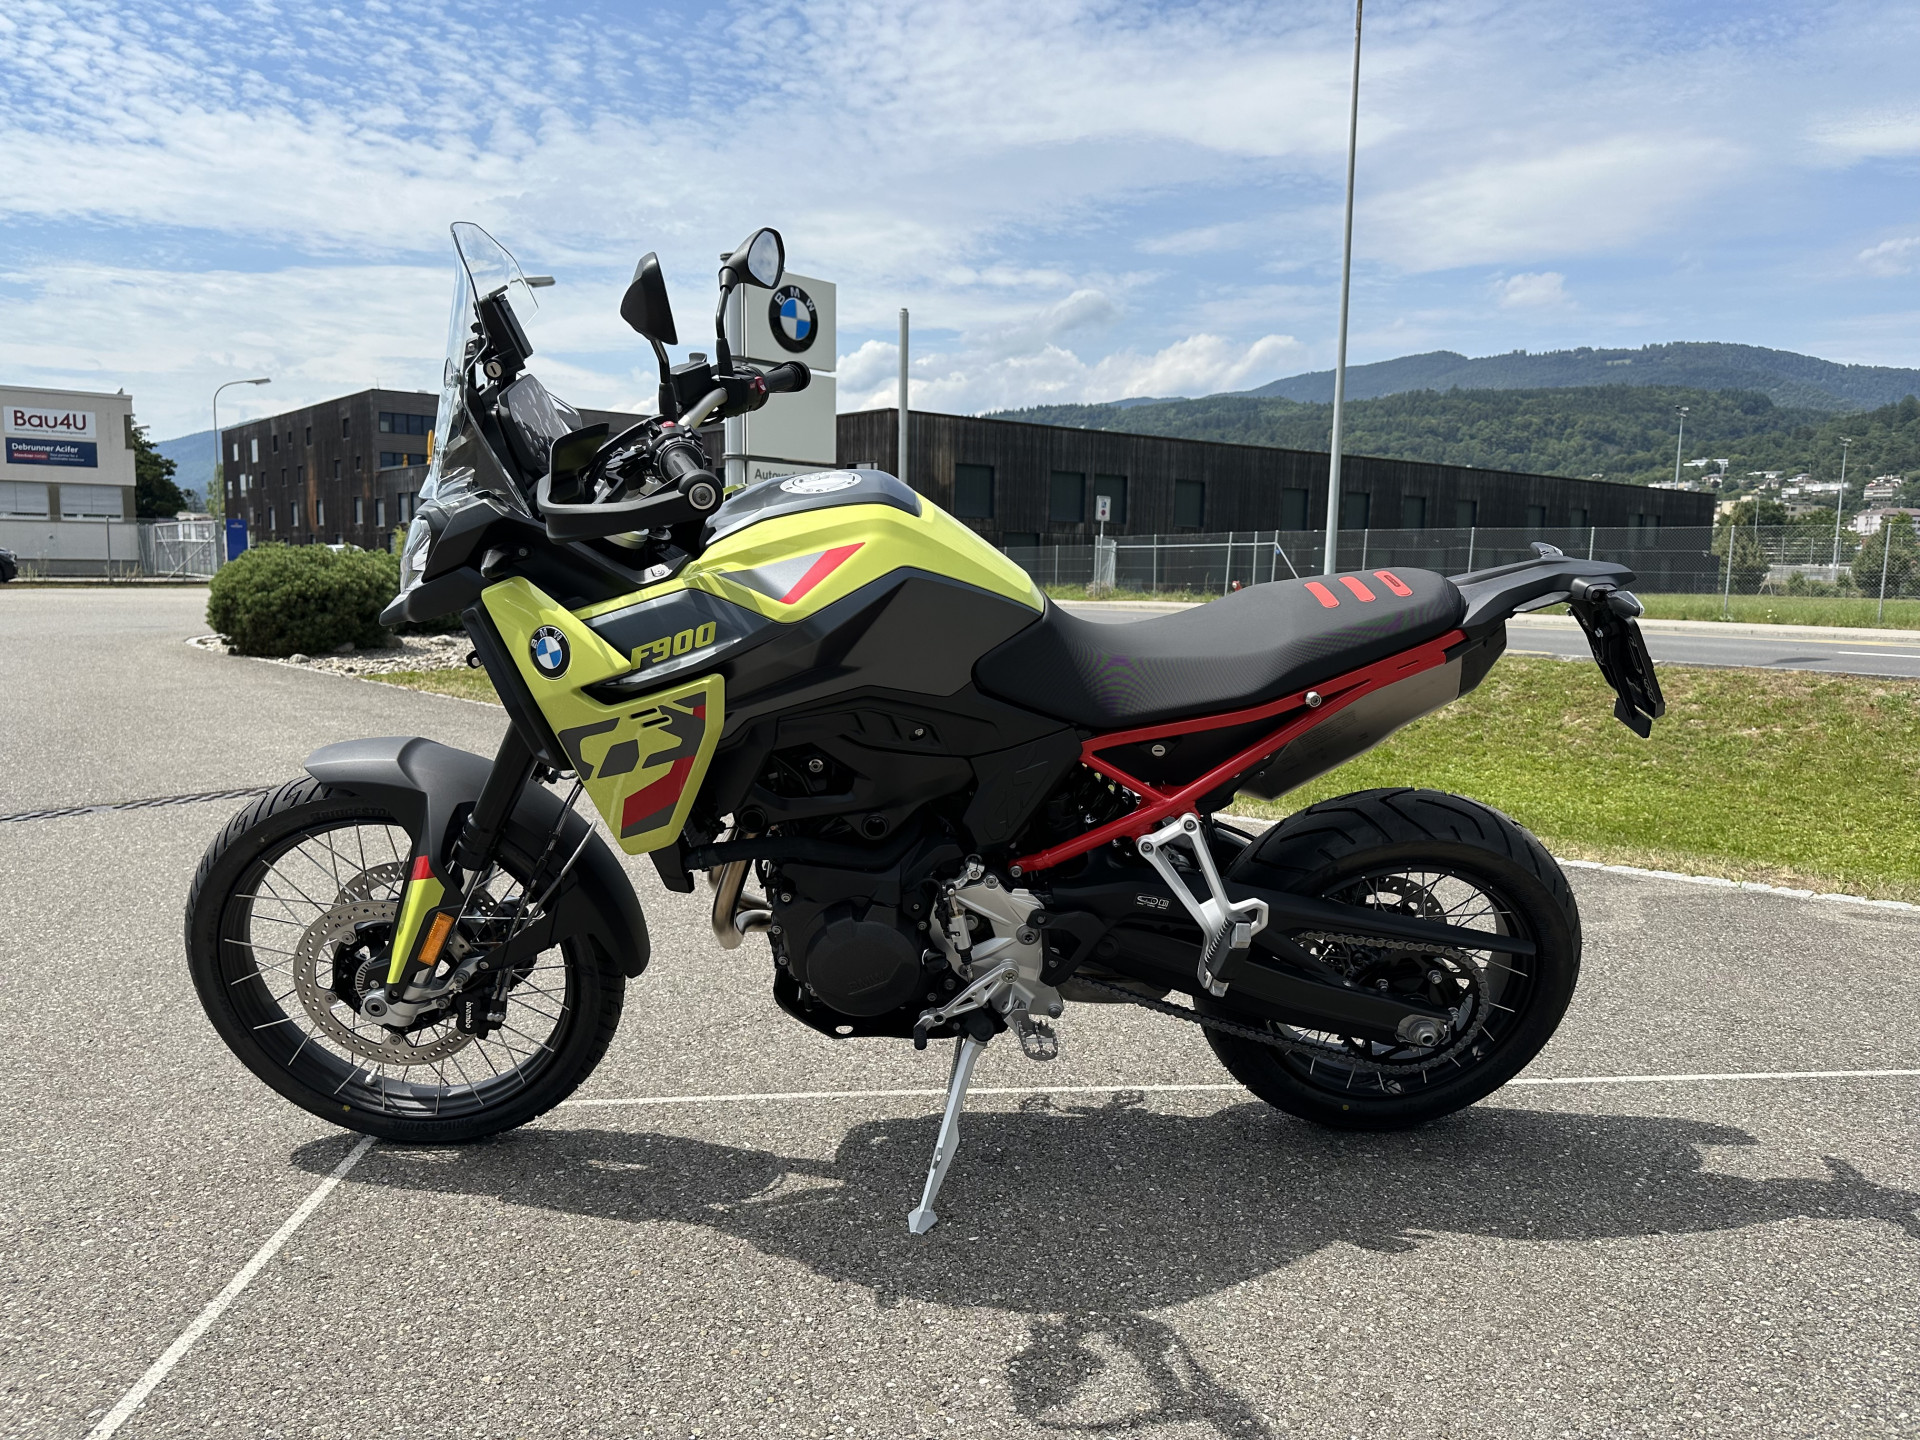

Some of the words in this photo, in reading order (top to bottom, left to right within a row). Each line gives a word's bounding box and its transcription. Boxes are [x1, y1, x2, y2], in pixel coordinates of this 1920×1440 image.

[774, 287, 815, 312] BMW
[13, 409, 87, 431] Bau4U
[11, 442, 54, 453] Debrunner
[55, 444, 79, 454] Acifer
[531, 627, 563, 649] BMW
[630, 621, 717, 671] F900
[465, 1001, 474, 1029] brembo
